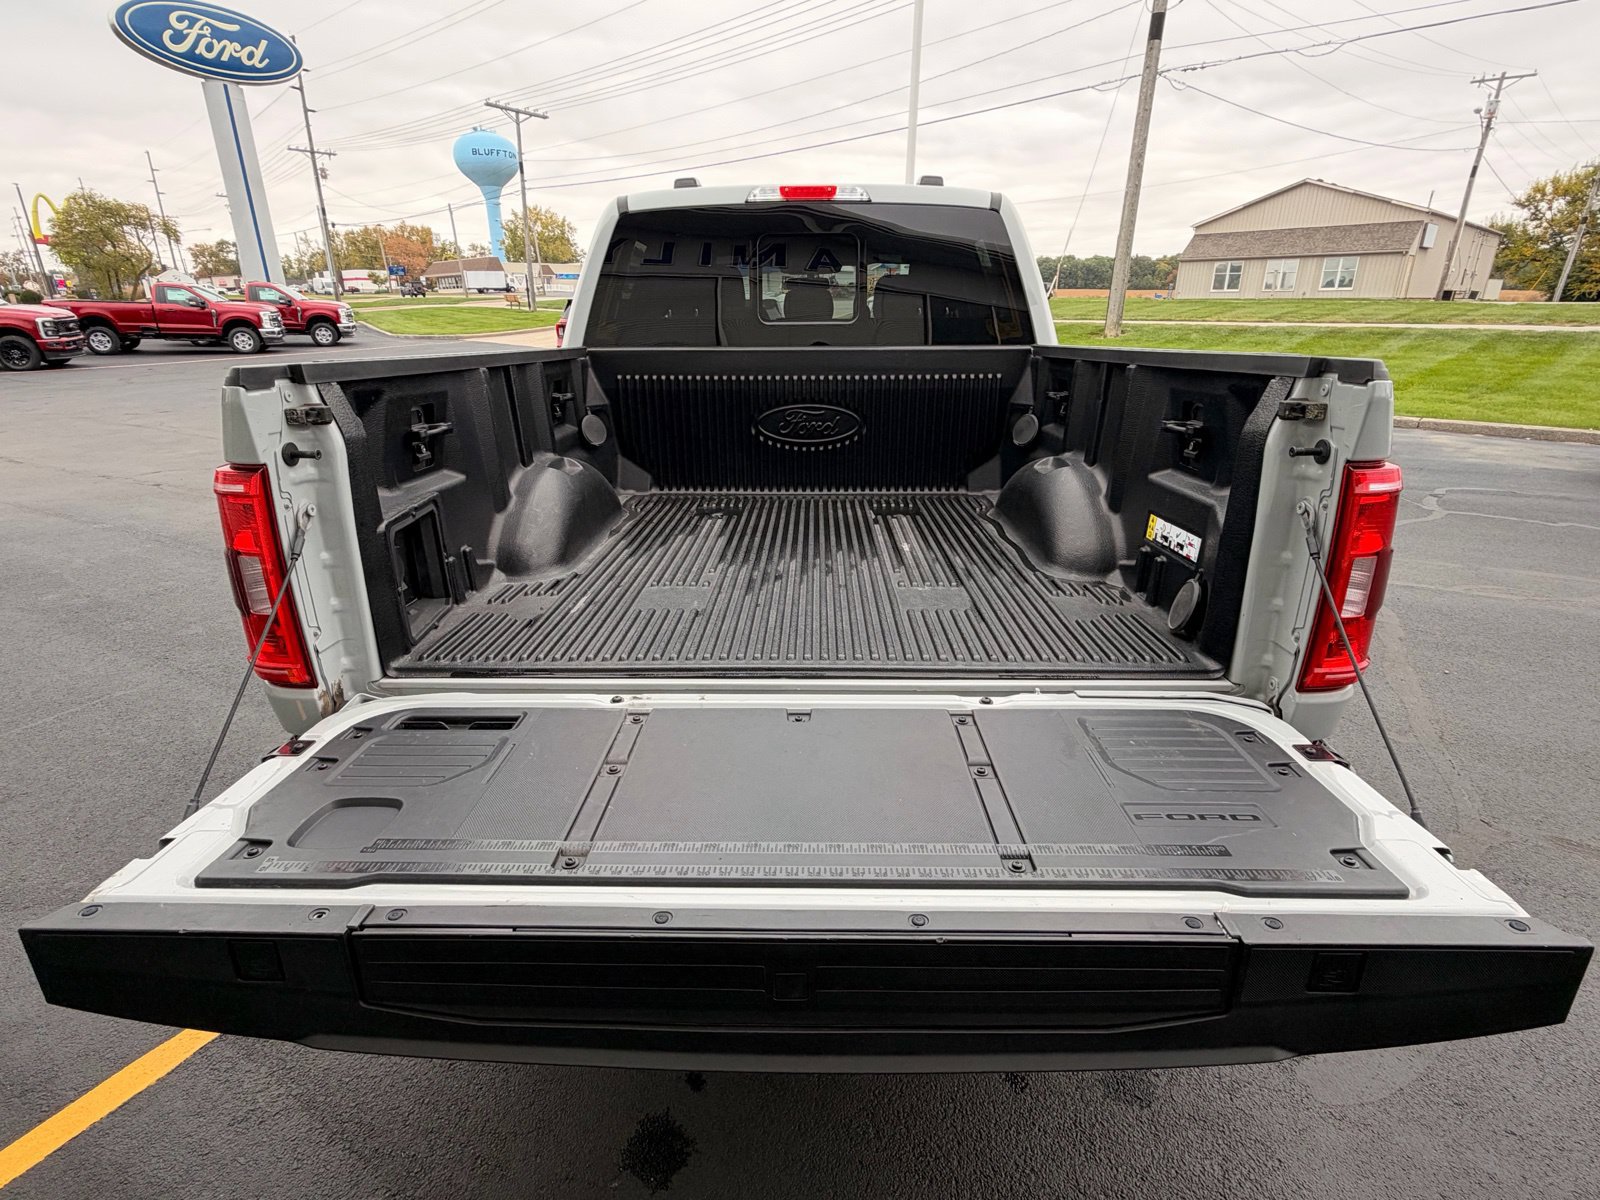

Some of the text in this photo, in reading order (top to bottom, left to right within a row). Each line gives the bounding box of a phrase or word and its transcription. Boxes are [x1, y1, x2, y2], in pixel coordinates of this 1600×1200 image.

[162, 10, 269, 69] Ford
[471, 147, 517, 160] BLUFFTON
[779, 408, 840, 434] Ford
[1133, 813, 1262, 822] FORD
